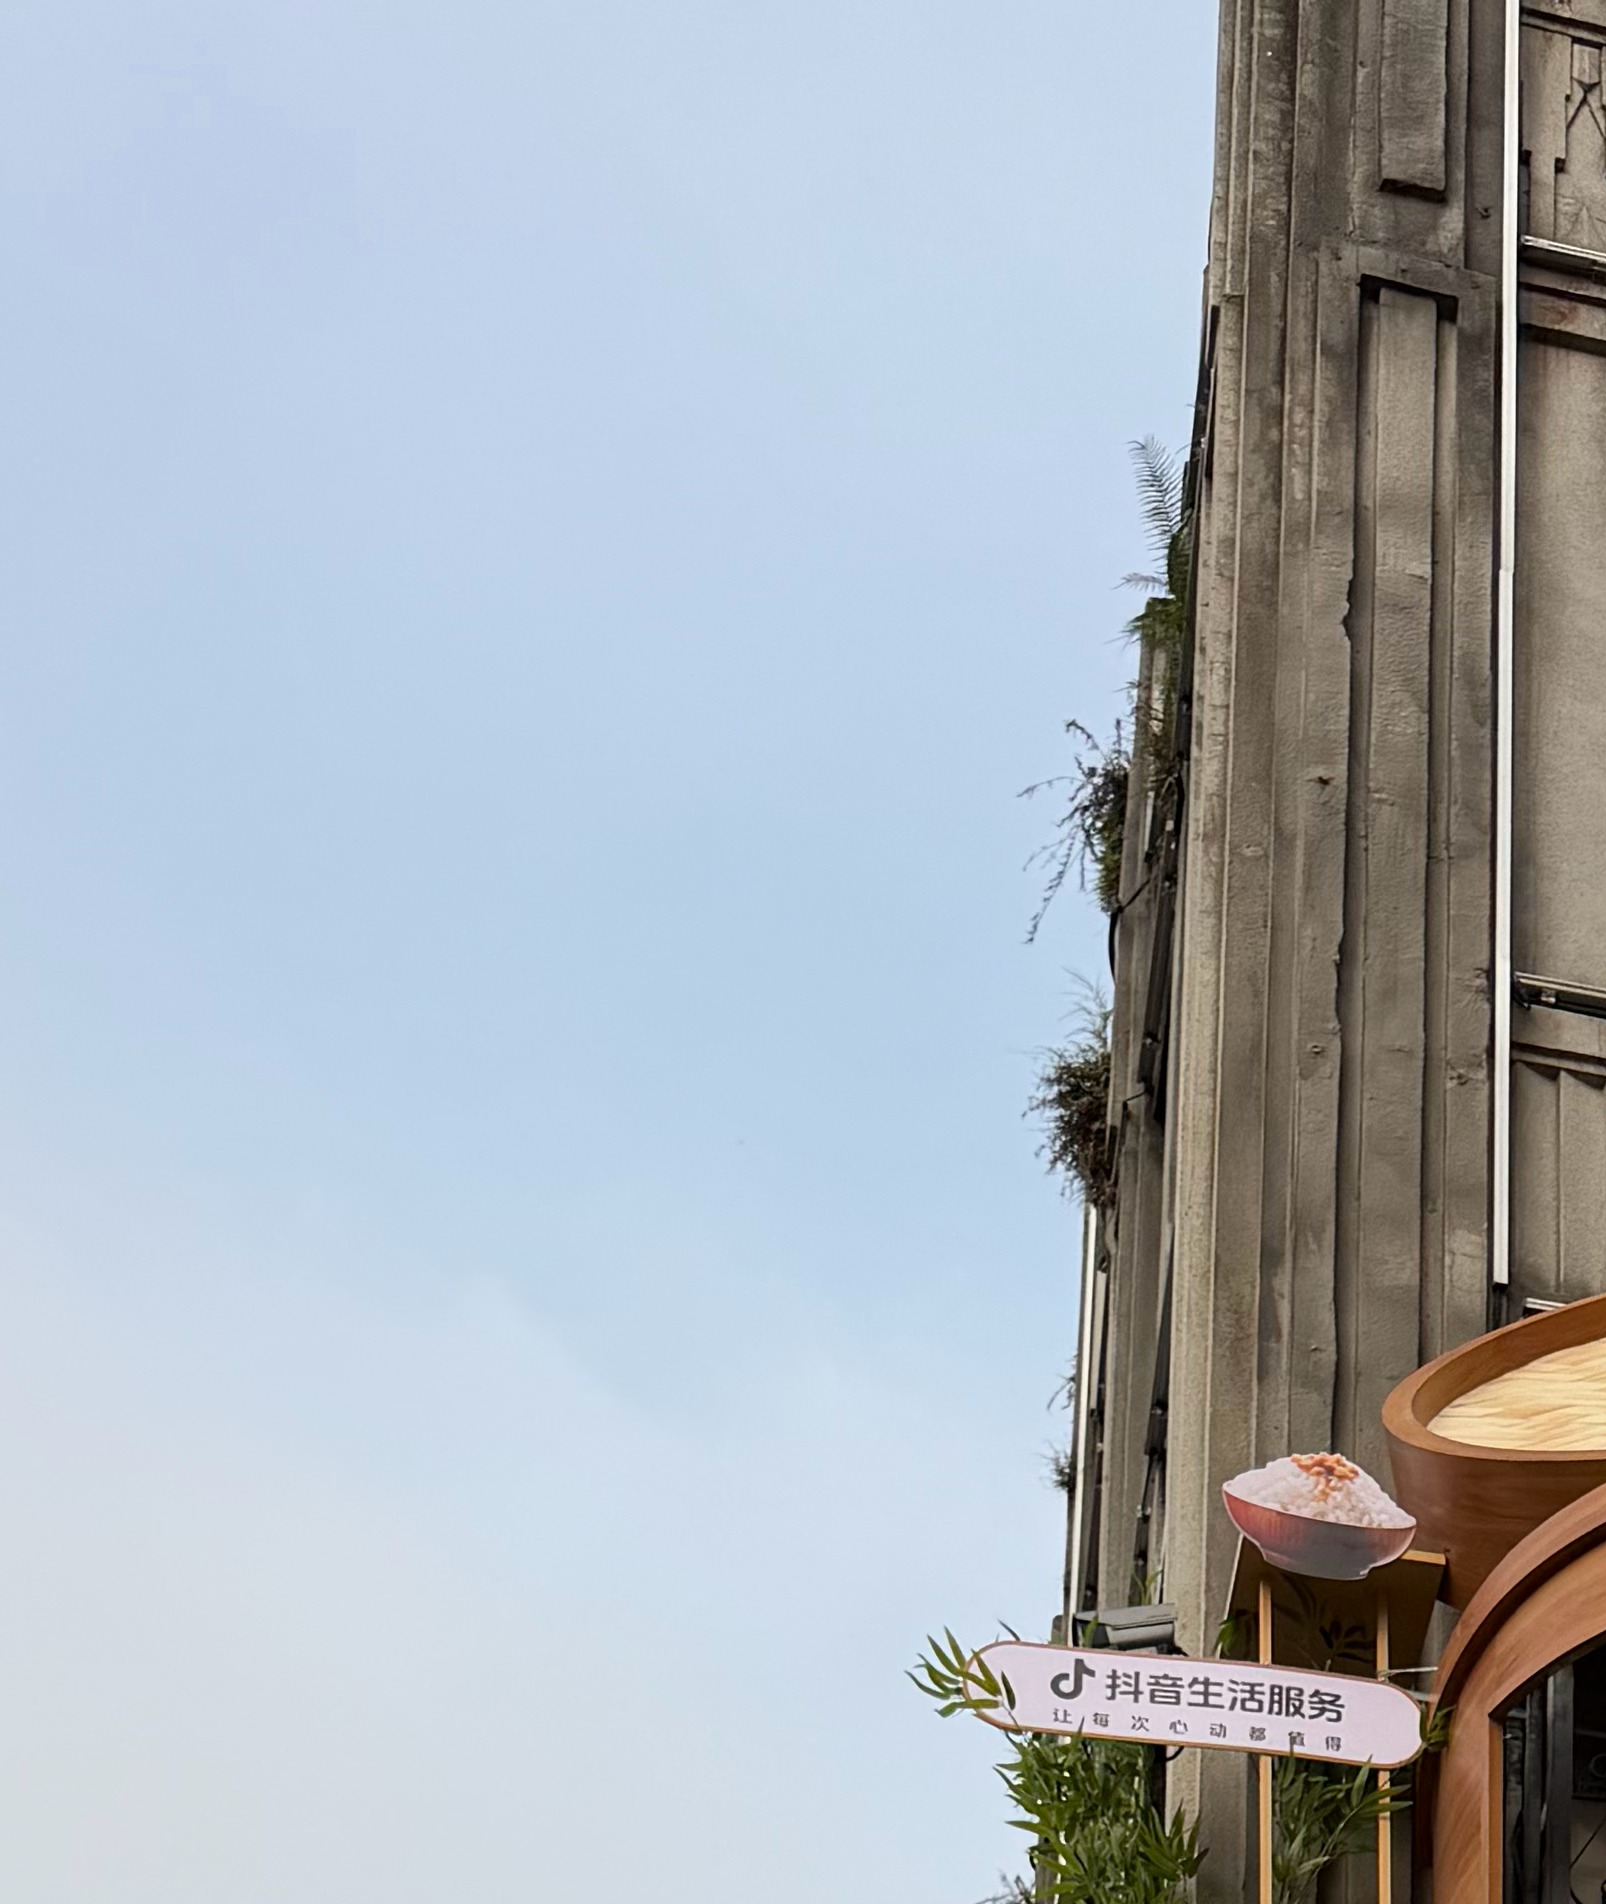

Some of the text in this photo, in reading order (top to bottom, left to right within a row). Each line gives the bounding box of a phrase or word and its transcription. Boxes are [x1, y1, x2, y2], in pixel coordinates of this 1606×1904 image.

[1105, 1667, 1346, 1723] 抖音生活服务
[1052, 1707, 1342, 1752] 让每次心动都值得
